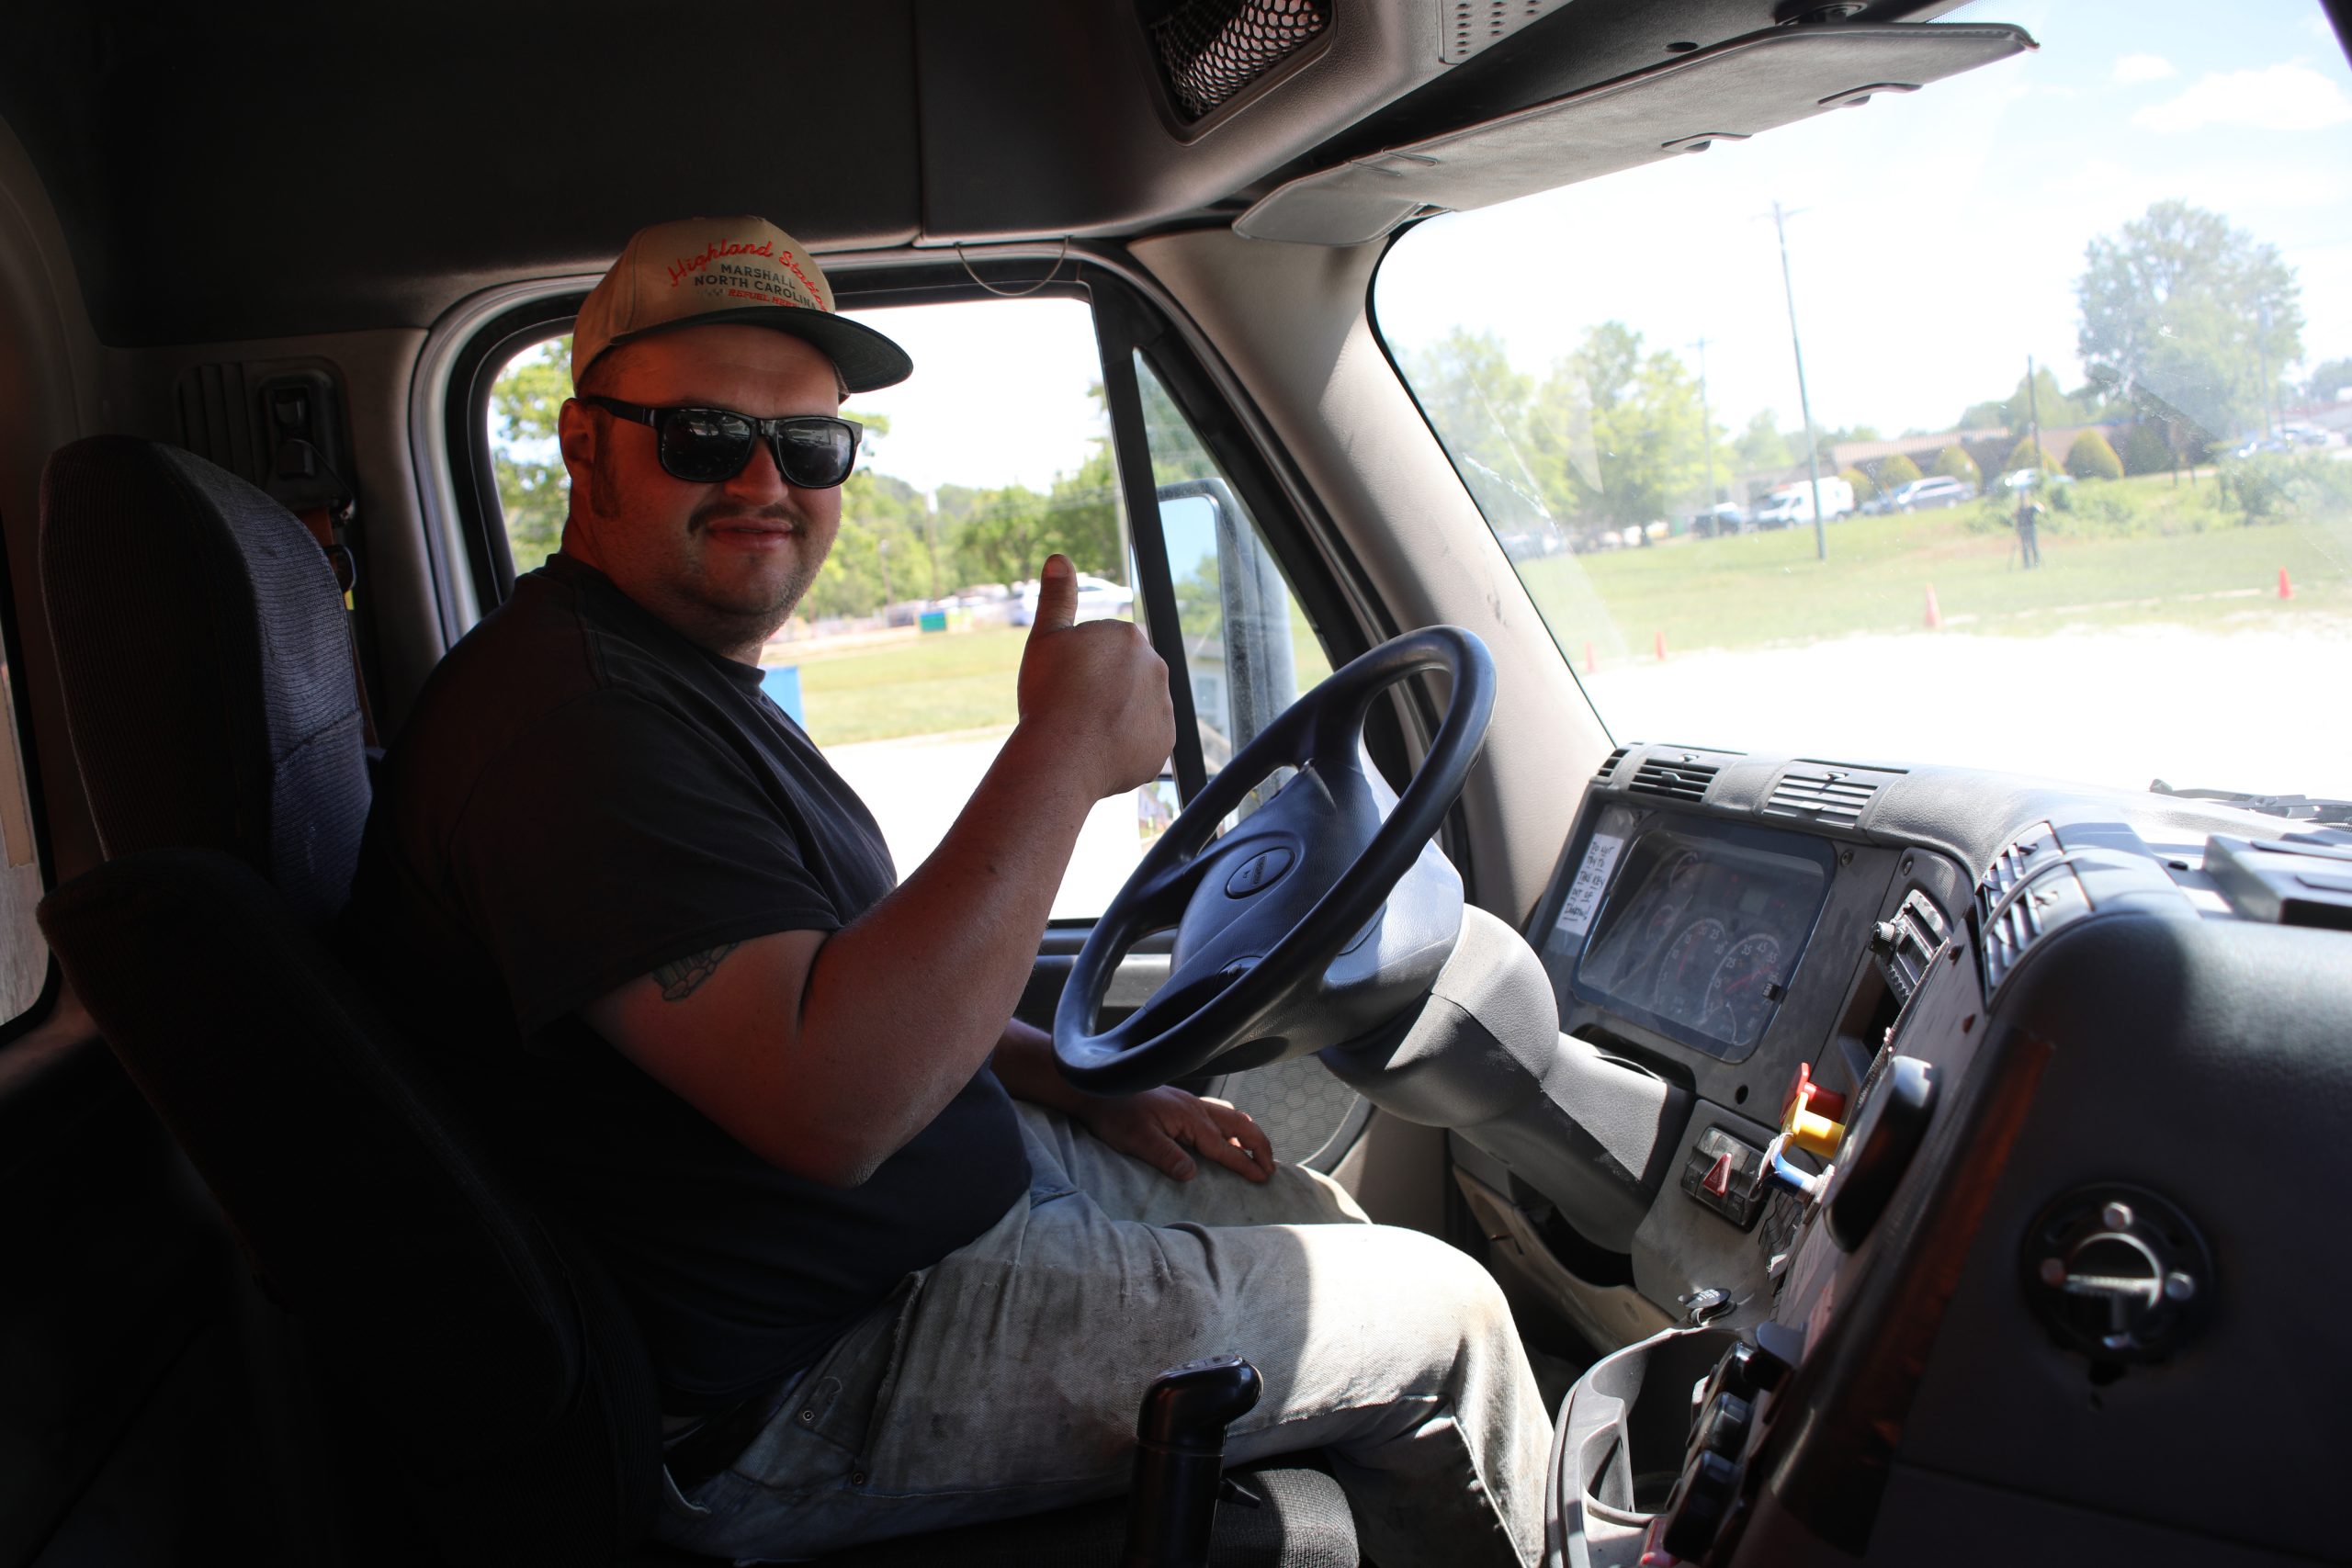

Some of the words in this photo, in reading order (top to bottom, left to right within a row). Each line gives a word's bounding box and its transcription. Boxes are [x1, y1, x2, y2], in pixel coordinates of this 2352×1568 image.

[667, 238, 775, 288] Highland
[720, 263, 797, 290] MARSHALL
[694, 274, 749, 288] NORTH
[753, 280, 817, 310] CAROLINA
[728, 288, 770, 302] REFUEL
[1741, 943, 1753, 955] 35
